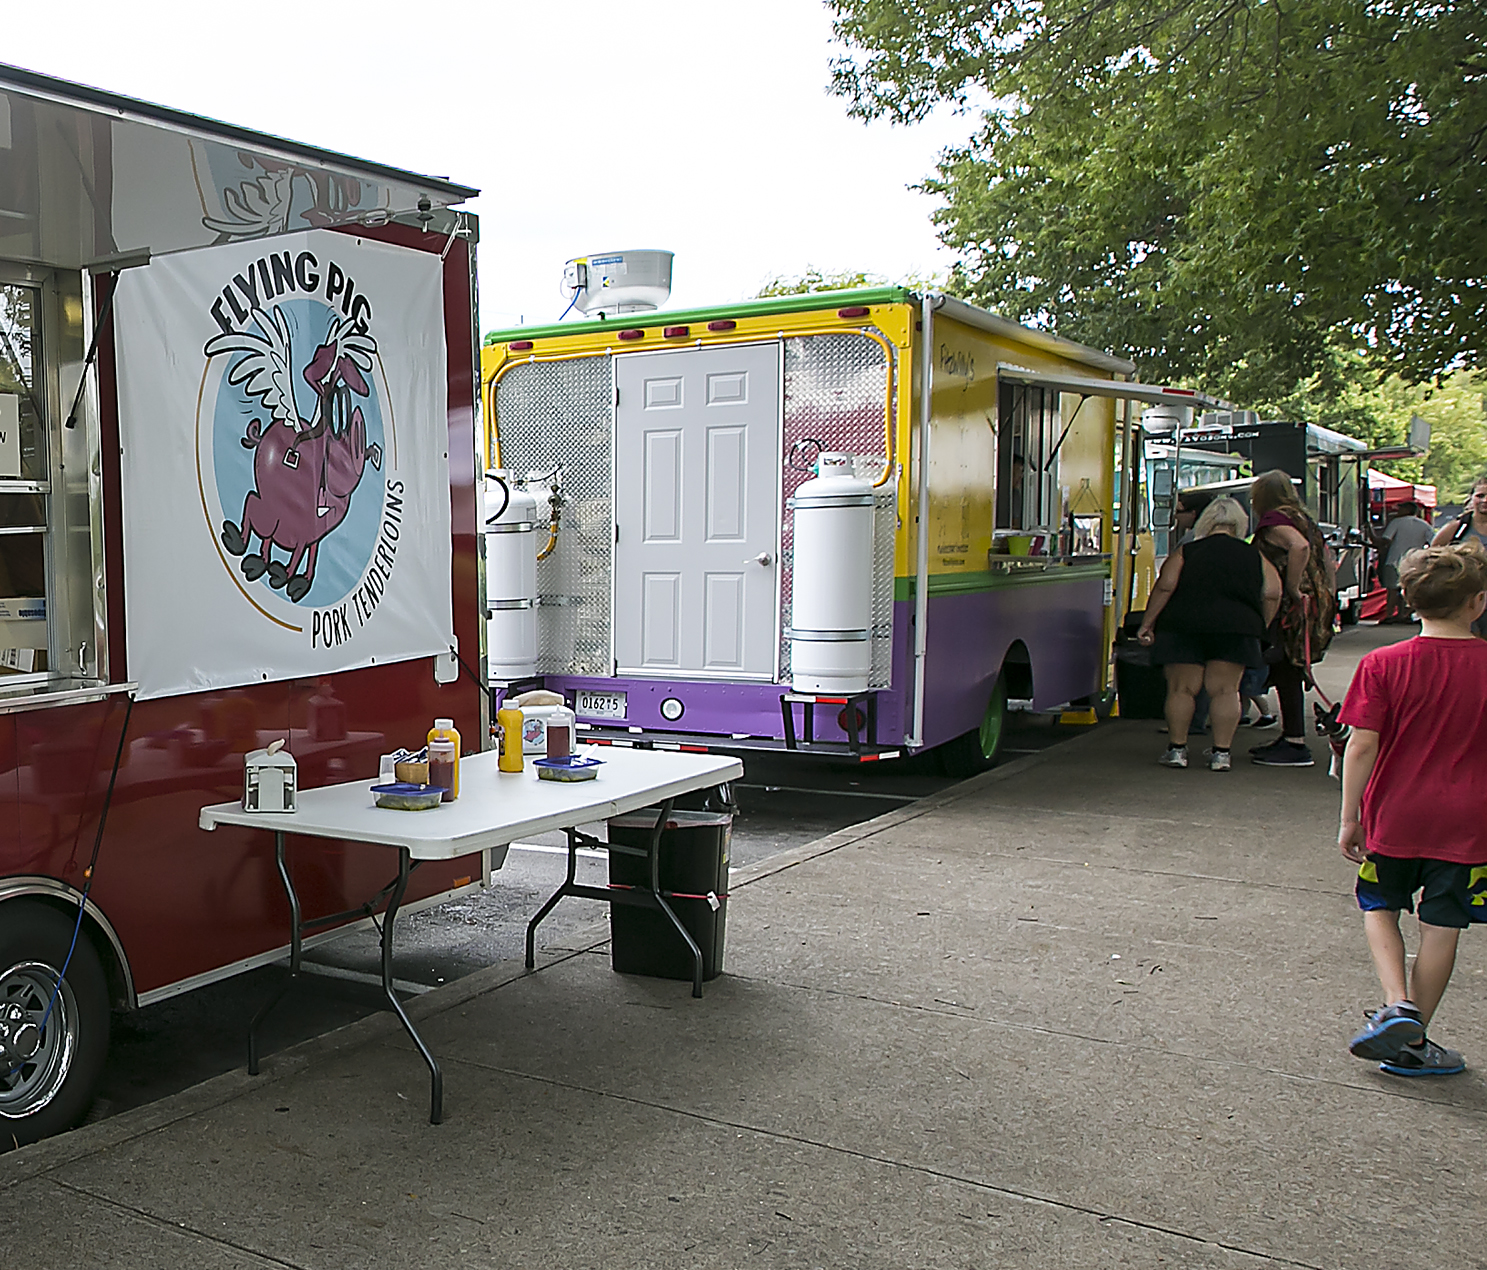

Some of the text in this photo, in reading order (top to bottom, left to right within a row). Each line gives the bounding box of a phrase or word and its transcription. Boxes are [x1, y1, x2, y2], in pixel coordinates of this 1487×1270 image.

[210, 250, 372, 335] FLYING PIG
[312, 479, 404, 649] PORK TENDERLOINS
